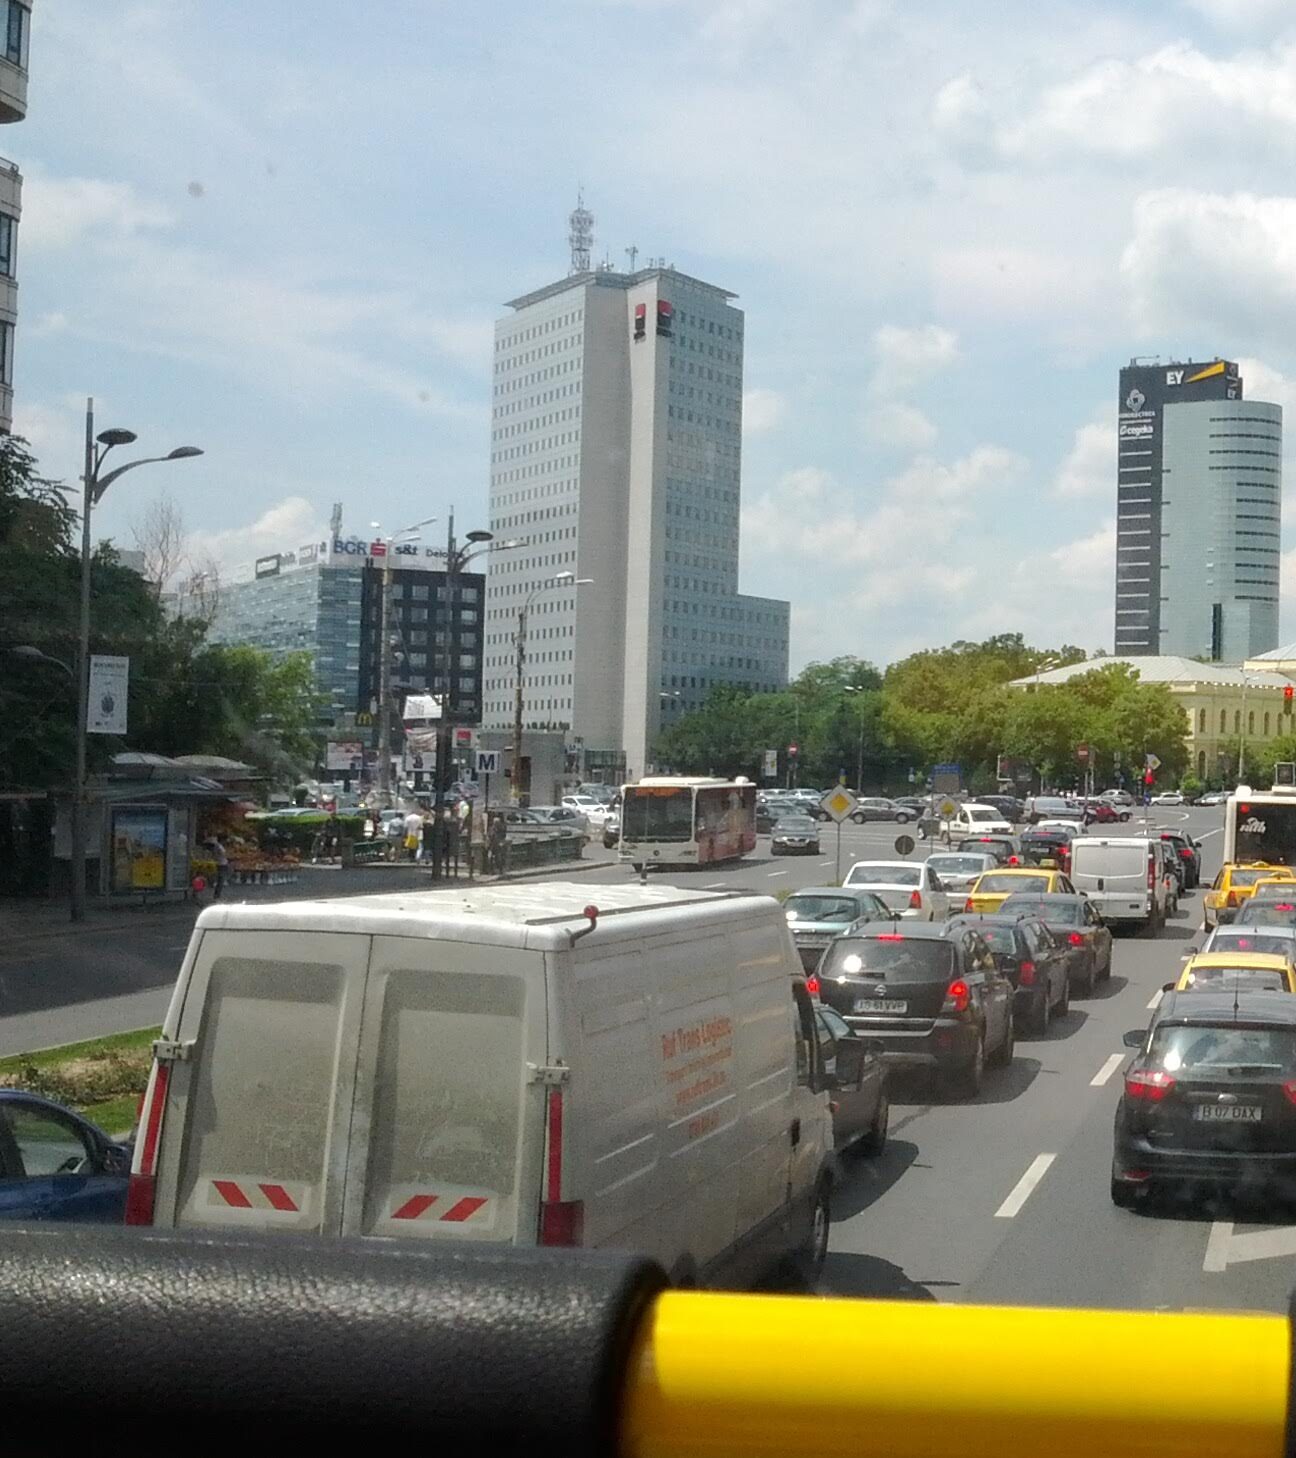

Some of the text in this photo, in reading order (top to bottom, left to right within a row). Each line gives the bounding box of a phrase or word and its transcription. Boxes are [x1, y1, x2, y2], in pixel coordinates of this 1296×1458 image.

[1166, 370, 1184, 385] EY
[334, 540, 367, 555] BCR
[478, 754, 495, 771] M
[1203, 1105, 1211, 1117] B
